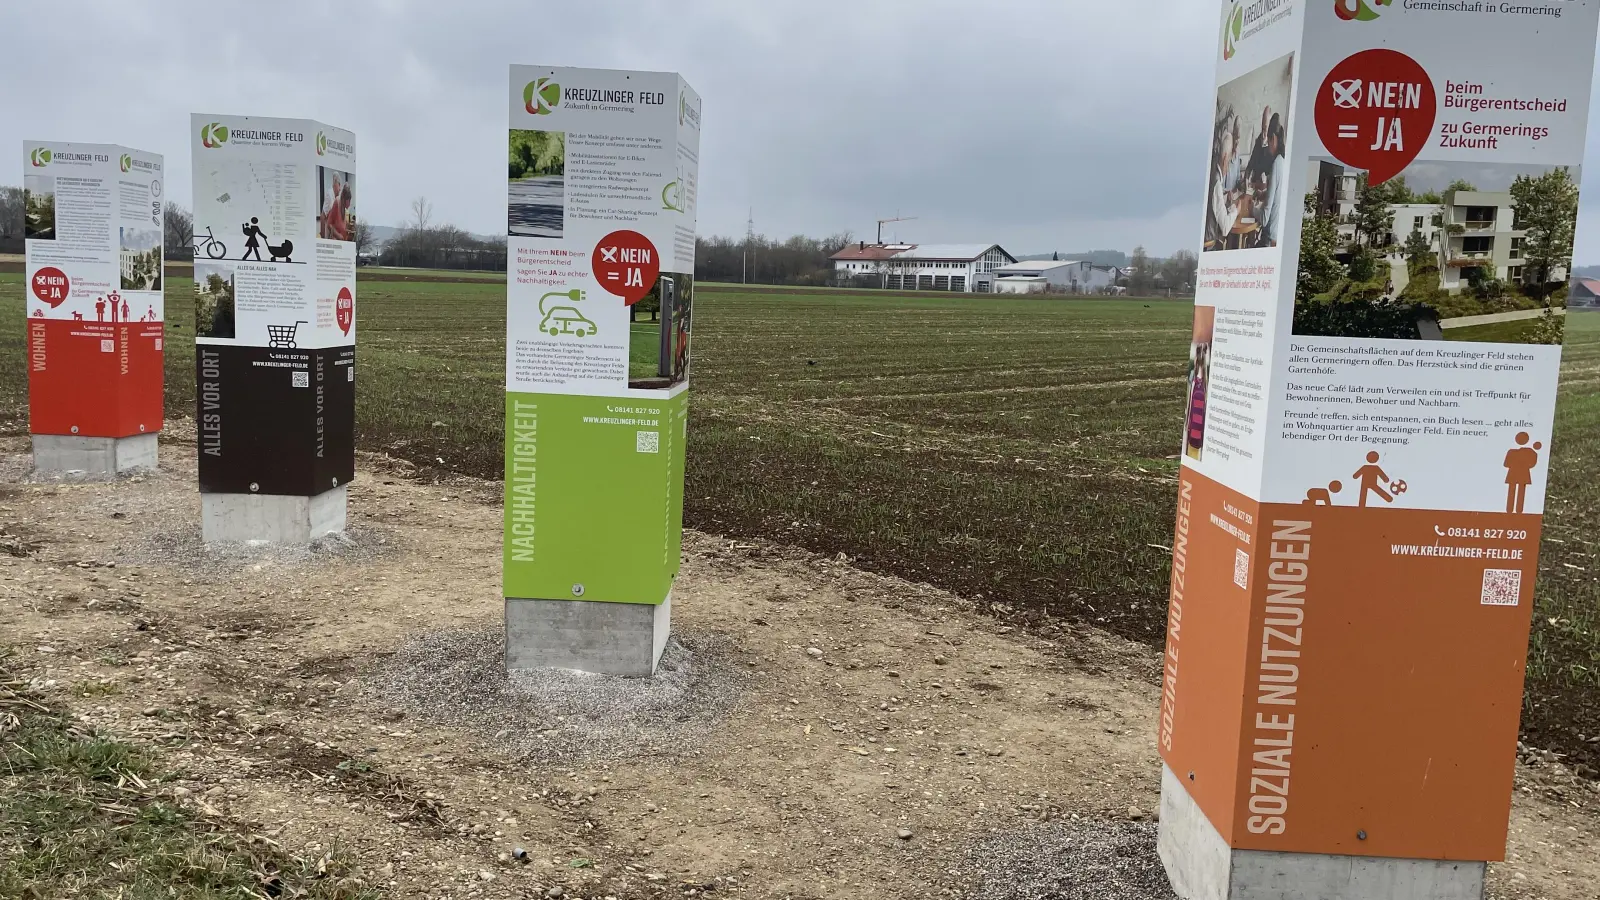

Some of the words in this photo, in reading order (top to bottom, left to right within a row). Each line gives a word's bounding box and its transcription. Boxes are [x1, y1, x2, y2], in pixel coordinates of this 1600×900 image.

[1403, 0, 1482, 12] Gemeinschaft
[1485, 3, 1496, 13] in
[1499, 4, 1562, 18] Germering
[1367, 82, 1420, 109] NEIN
[1445, 80, 1482, 95] beim
[565, 88, 634, 104] KREUZLINGER
[640, 92, 664, 105] FELD
[1444, 95, 1566, 113] Bürgerentscheid
[564, 102, 590, 110] Zukunft
[599, 104, 634, 113] Germering
[231, 130, 281, 141] KREUZLINGER
[286, 132, 303, 142] FELD
[1370, 117, 1404, 151] JA
[1441, 124, 1458, 135] zu
[1462, 122, 1548, 139] Germerings
[1440, 135, 1498, 150] Zukunft
[54, 153, 92, 161] KREUZLINGER
[621, 248, 650, 264] NEIN
[48, 277, 64, 285] NEIN
[517, 277, 567, 286] Nachhaltigkeit.
[625, 268, 643, 287] JA
[50, 287, 61, 298] JA
[344, 312, 349, 324] JA
[33, 323, 46, 371] WOHNEN
[1290, 344, 1304, 352] Die
[1306, 344, 1399, 356] Gemeinschaftsflächen
[1399, 348, 1414, 356] auf
[1415, 348, 1433, 357] dem
[1436, 349, 1485, 361] Kreuzlinger
[1487, 351, 1504, 360] Feld
[1506, 352, 1533, 361] stehen
[202, 350, 219, 377] ORT
[1288, 355, 1308, 364] allen
[1311, 356, 1369, 367] Germeringern
[1372, 358, 1394, 367] offen.
[1397, 359, 1413, 367] Das
[1416, 360, 1458, 369] Herzstück
[1460, 361, 1477, 370] sind
[1479, 362, 1492, 370] die
[1494, 362, 1523, 372] grünen
[1288, 366, 1336, 375] Gartenhöfe.
[203, 380, 220, 410] VOR
[1286, 382, 1302, 391] Das
[1327, 384, 1346, 392] Café
[1348, 384, 1363, 393] lädt
[1386, 386, 1426, 396] Verweilen
[1429, 388, 1441, 396] ein
[1444, 389, 1460, 397] und
[1462, 389, 1472, 398] ist
[1474, 390, 1516, 401] Treffpunkt
[1519, 391, 1530, 400] für
[1286, 392, 1352, 404] Bewohnerinnen,
[1355, 395, 1397, 404] Bewohner
[1399, 397, 1415, 405] und
[1418, 397, 1460, 407] Nachbarn.
[583, 416, 659, 427] WWW.KREUZLINGER-FELD.DE
[1284, 410, 1318, 419] Freunde
[1320, 411, 1349, 421] treffen,
[1351, 412, 1368, 421] sich
[1370, 413, 1420, 424] entspannen,
[1422, 415, 1435, 424] ein
[1438, 416, 1459, 424] Buch
[1461, 416, 1483, 425] lesen
[1494, 418, 1511, 428] geht
[1514, 419, 1533, 427] alles
[204, 414, 221, 457] ALLES
[1283, 420, 1293, 429] im
[1296, 421, 1354, 432] Wohnquartier
[1371, 424, 1421, 436] Kreuzlinger
[1446, 427, 1460, 435] Ein
[1282, 430, 1326, 442] lebendiger
[1328, 432, 1341, 441] Ort
[1344, 433, 1358, 442] der
[1361, 434, 1409, 445] Begegnung.
[512, 400, 537, 561] NACHHALTIGKEIT
[1447, 527, 1480, 538] 08141
[1483, 528, 1503, 539] 827
[1506, 529, 1526, 540] 920
[1390, 544, 1522, 560] WWW.KREUZLINGER-FELD.DE
[1161, 645, 1179, 751] SOZIALE
[1170, 480, 1192, 641] NUTZUNGEN
[1258, 519, 1312, 705] NUTZUNGEN
[1247, 712, 1294, 834] SOZIALE
